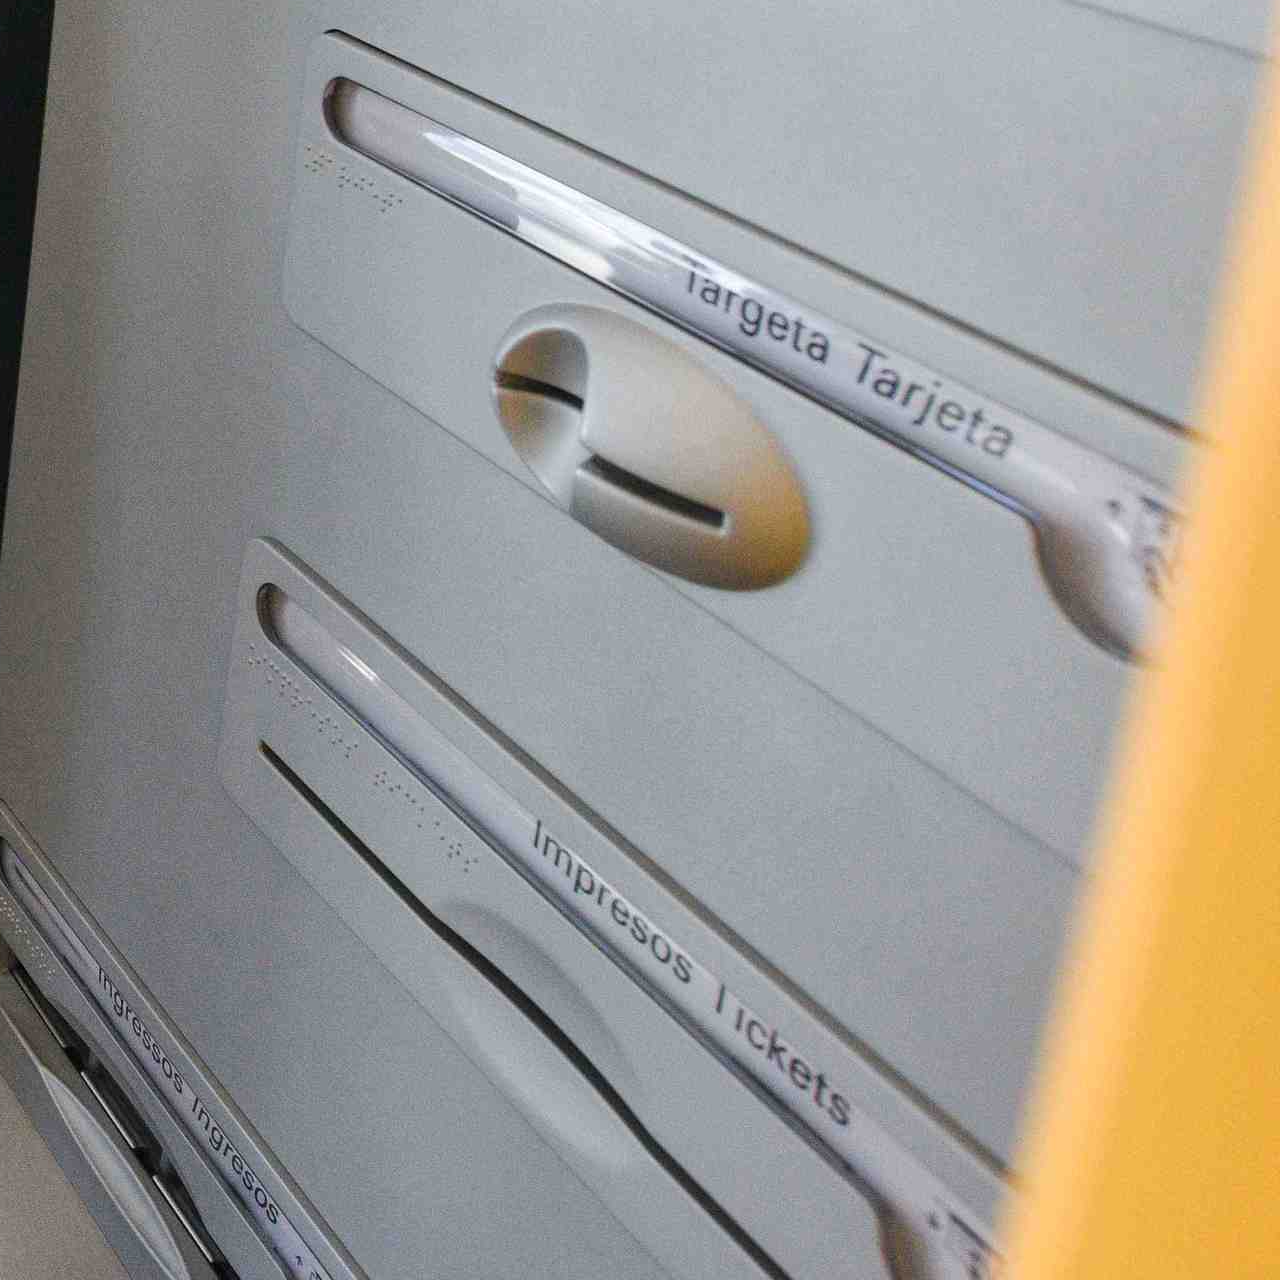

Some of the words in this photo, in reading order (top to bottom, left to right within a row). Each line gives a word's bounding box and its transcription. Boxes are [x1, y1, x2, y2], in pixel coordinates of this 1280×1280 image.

[685, 258, 832, 365] Targeta
[855, 341, 1016, 458] Tarjeta
[532, 819, 694, 984] Impresos
[96, 964, 184, 1095] Ingressos
[190, 1095, 280, 1226] Ingresos
